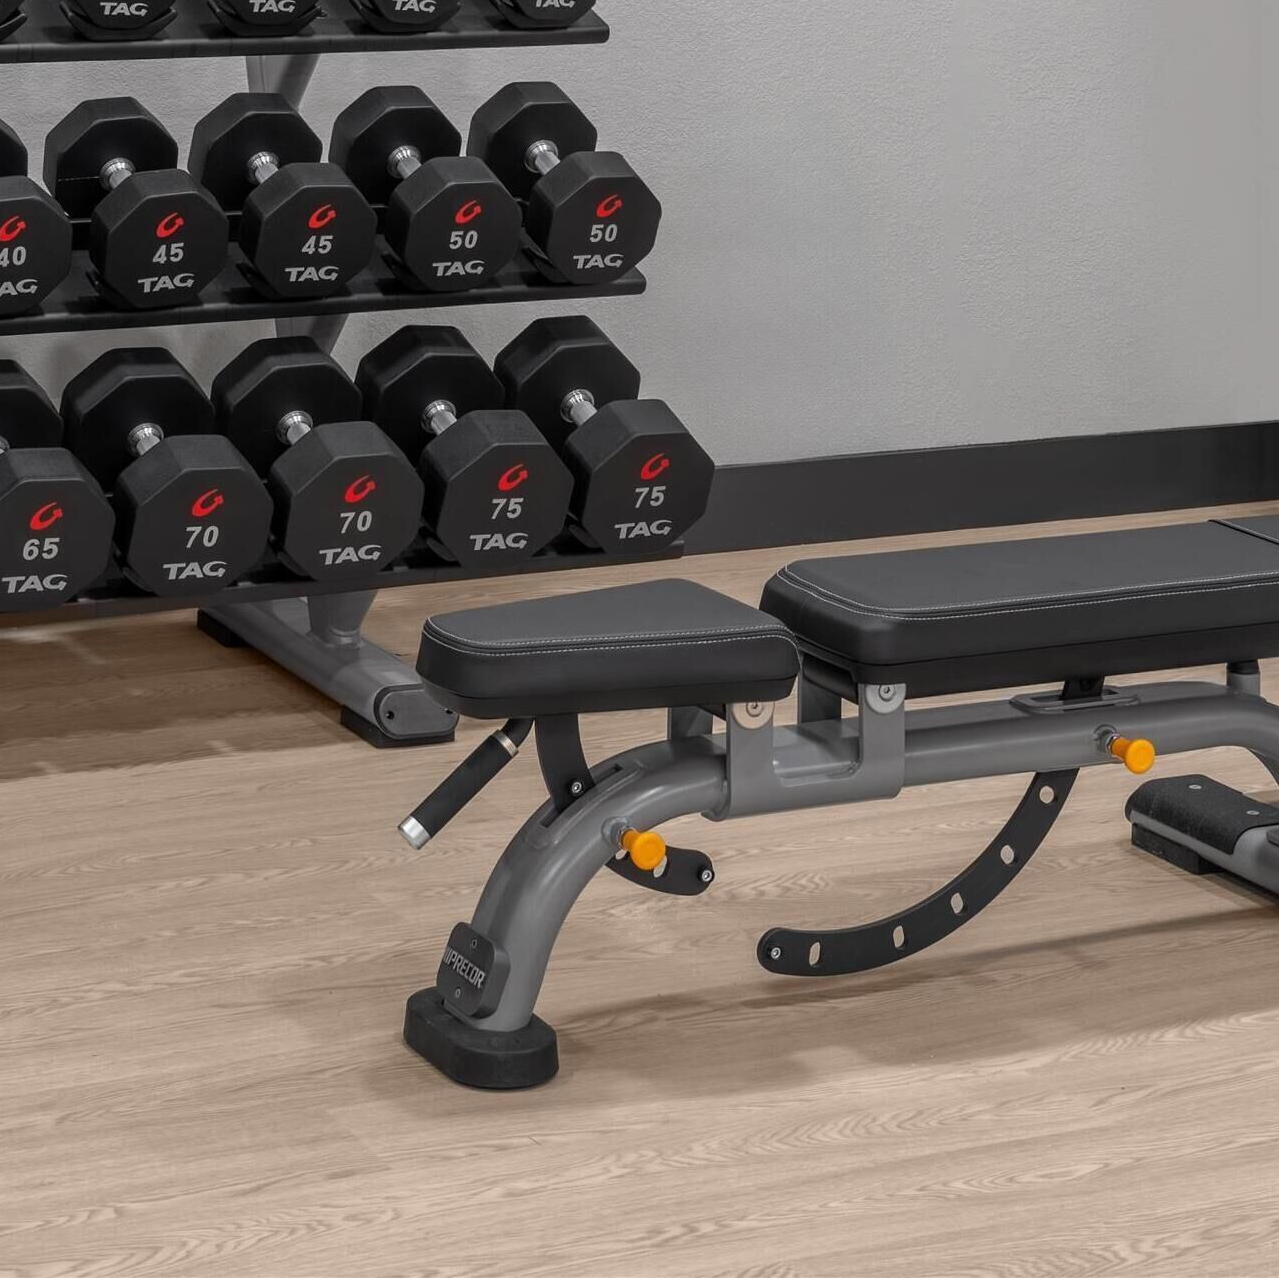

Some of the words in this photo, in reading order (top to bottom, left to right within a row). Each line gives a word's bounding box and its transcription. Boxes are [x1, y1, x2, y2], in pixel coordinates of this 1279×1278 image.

[99, 1, 148, 17] TAG
[448, 230, 479, 250] 50
[589, 223, 618, 243] 50
[152, 242, 185, 264] 45
[301, 234, 334, 255] 45
[432, 259, 485, 277] TAG
[572, 253, 624, 270] TAG
[137, 272, 195, 293] TAG
[284, 265, 339, 282] TAG
[634, 485, 667, 509] 75
[491, 497, 525, 520] 75
[339, 510, 373, 535] 70
[614, 518, 674, 540] TAG
[185, 525, 219, 549] 70
[469, 532, 529, 551] TAG
[22, 537, 61, 561] 65
[318, 544, 382, 566] TAG
[162, 560, 228, 580] TAG
[1, 573, 68, 594] TAG
[446, 950, 486, 989] PRECOR
